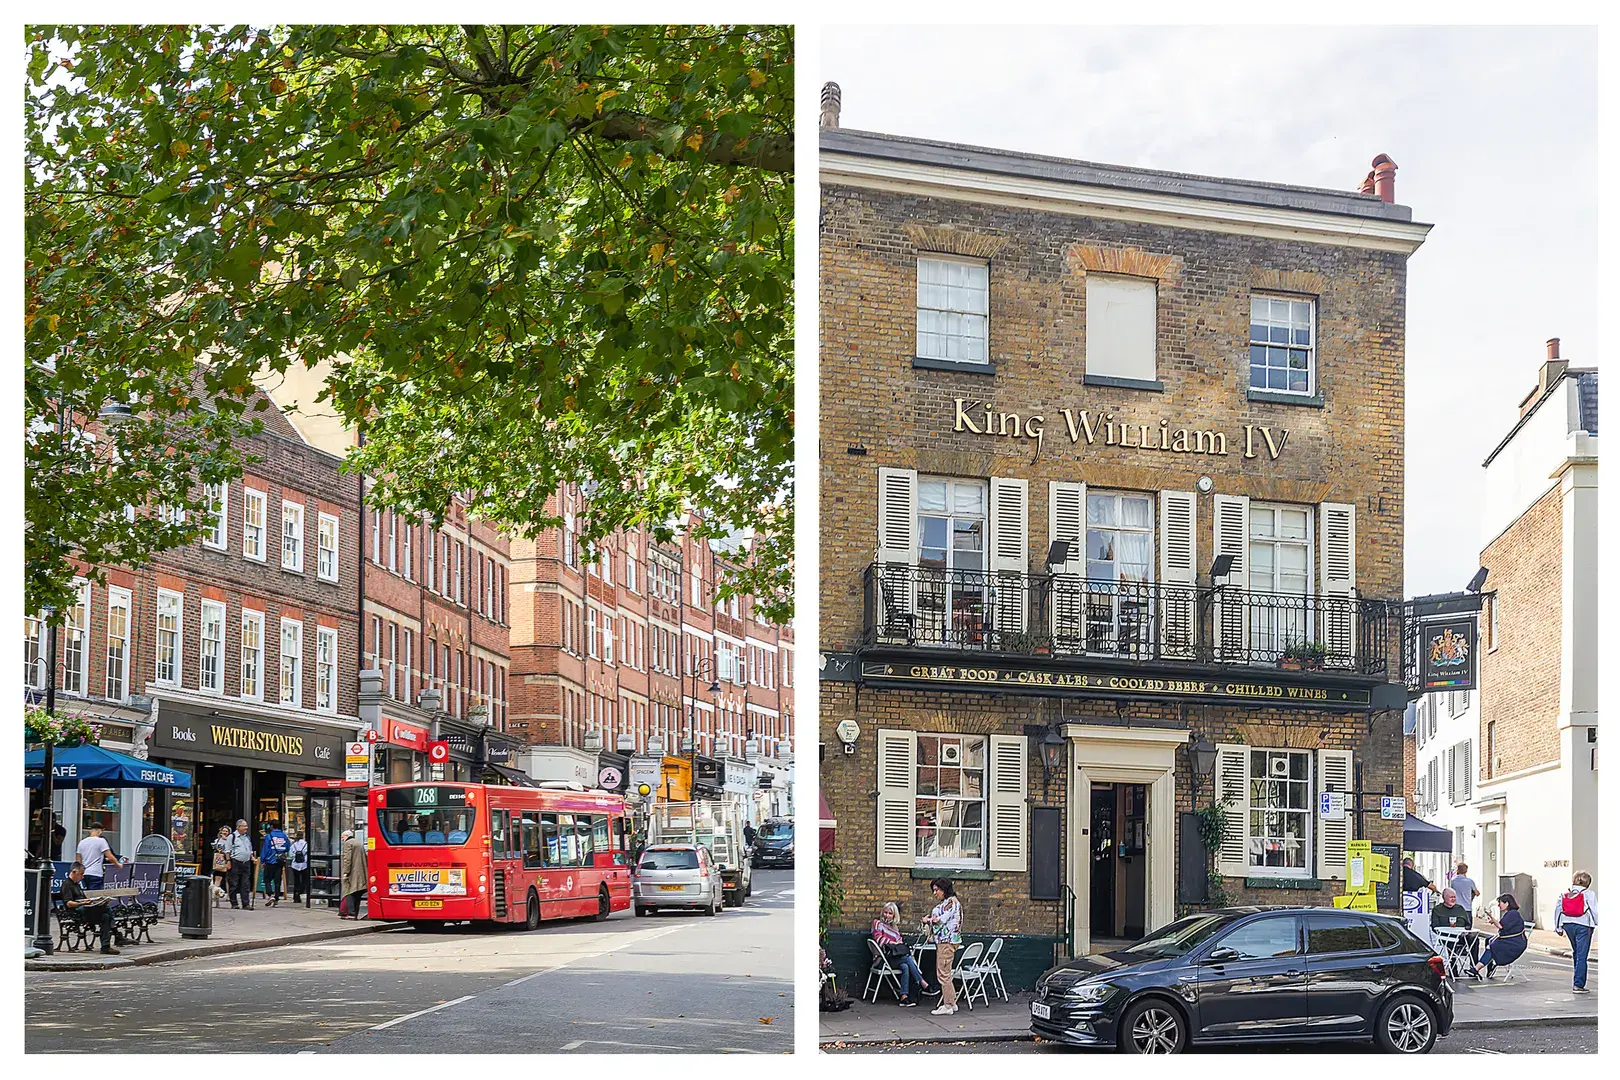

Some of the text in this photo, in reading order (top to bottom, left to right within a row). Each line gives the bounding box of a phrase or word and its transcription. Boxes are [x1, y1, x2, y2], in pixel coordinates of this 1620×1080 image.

[953, 398, 1045, 465] King
[1245, 423, 1290, 461] IV
[910, 666, 998, 681] GREAT FOOD
[1018, 672, 1088, 686] CASK ALES
[1109, 677, 1206, 693] COOLED BEERS
[1226, 683, 1327, 699] CHILLED WINES
[172, 725, 331, 760] Books WATERSTONES Café
[369, 730, 377, 740] B
[52, 764, 78, 777] AFÉ
[140, 770, 175, 784] FISH CAFÉ
[417, 788, 435, 803] 268
[396, 870, 440, 882] wellkid
